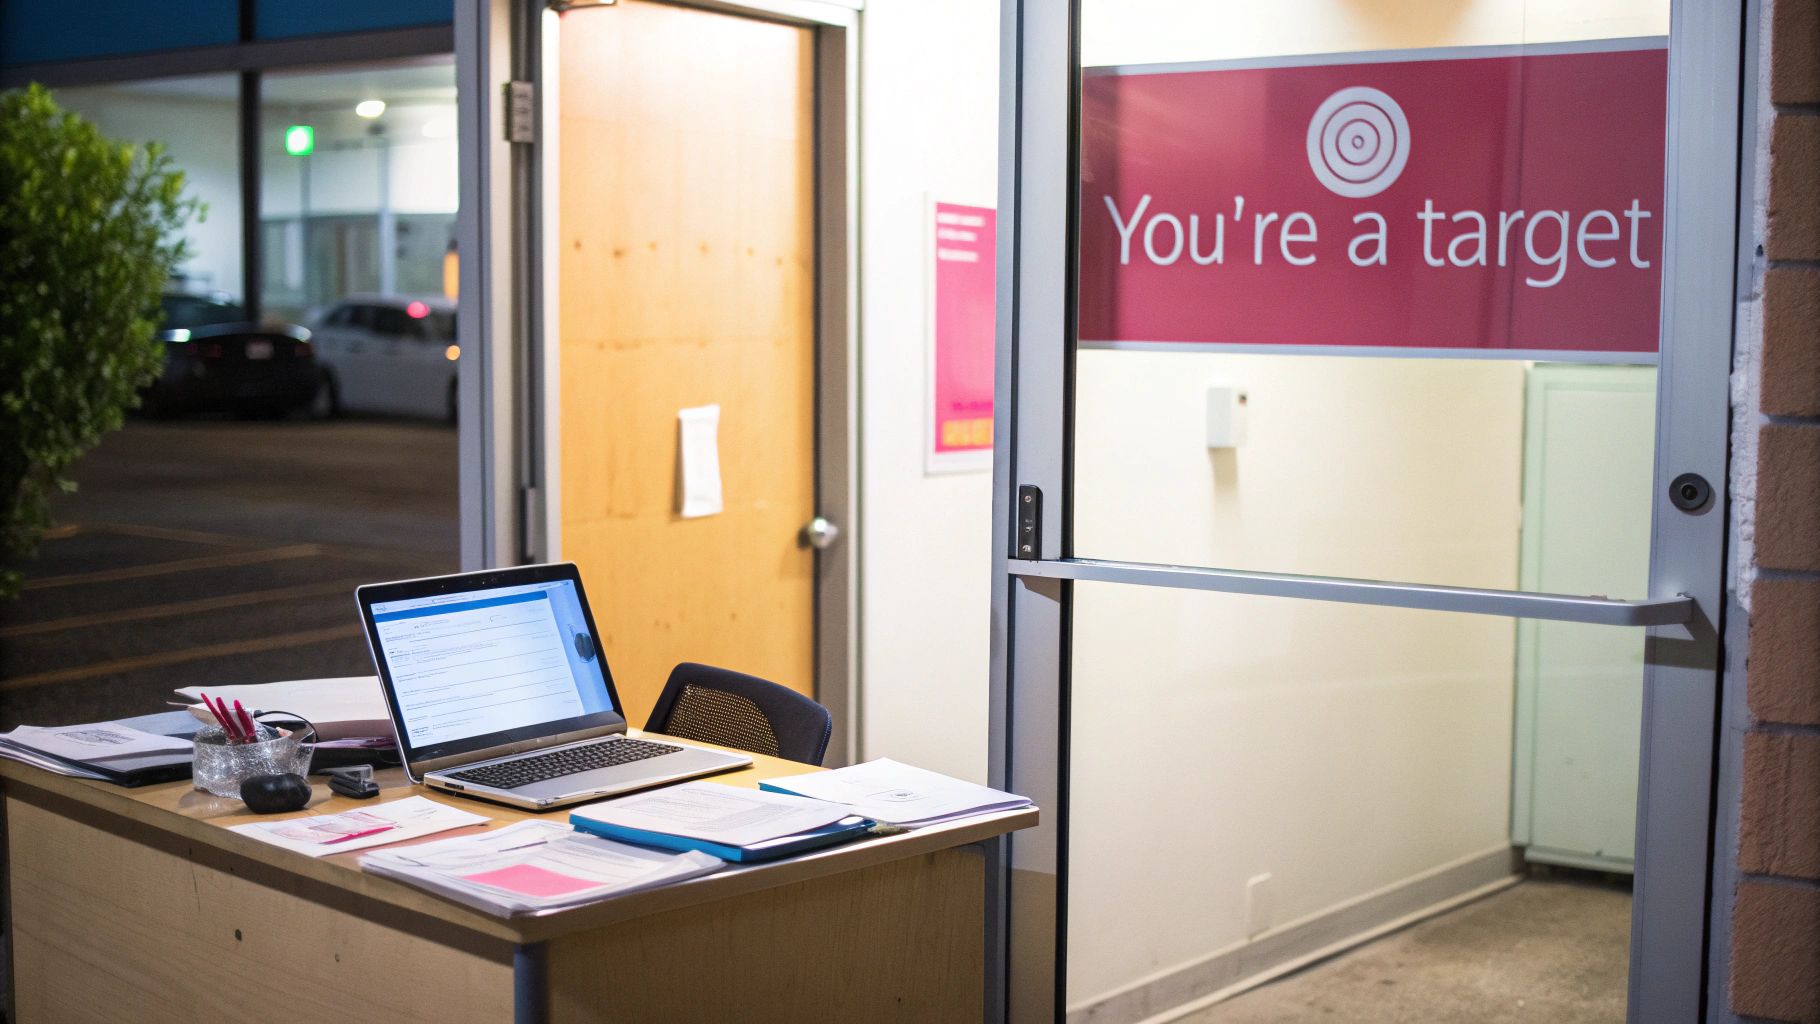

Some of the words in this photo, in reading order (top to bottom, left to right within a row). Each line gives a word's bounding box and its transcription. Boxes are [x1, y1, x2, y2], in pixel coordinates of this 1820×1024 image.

[1103, 194, 1318, 266] You're
[1347, 211, 1388, 267] a
[1416, 198, 1652, 288] target
